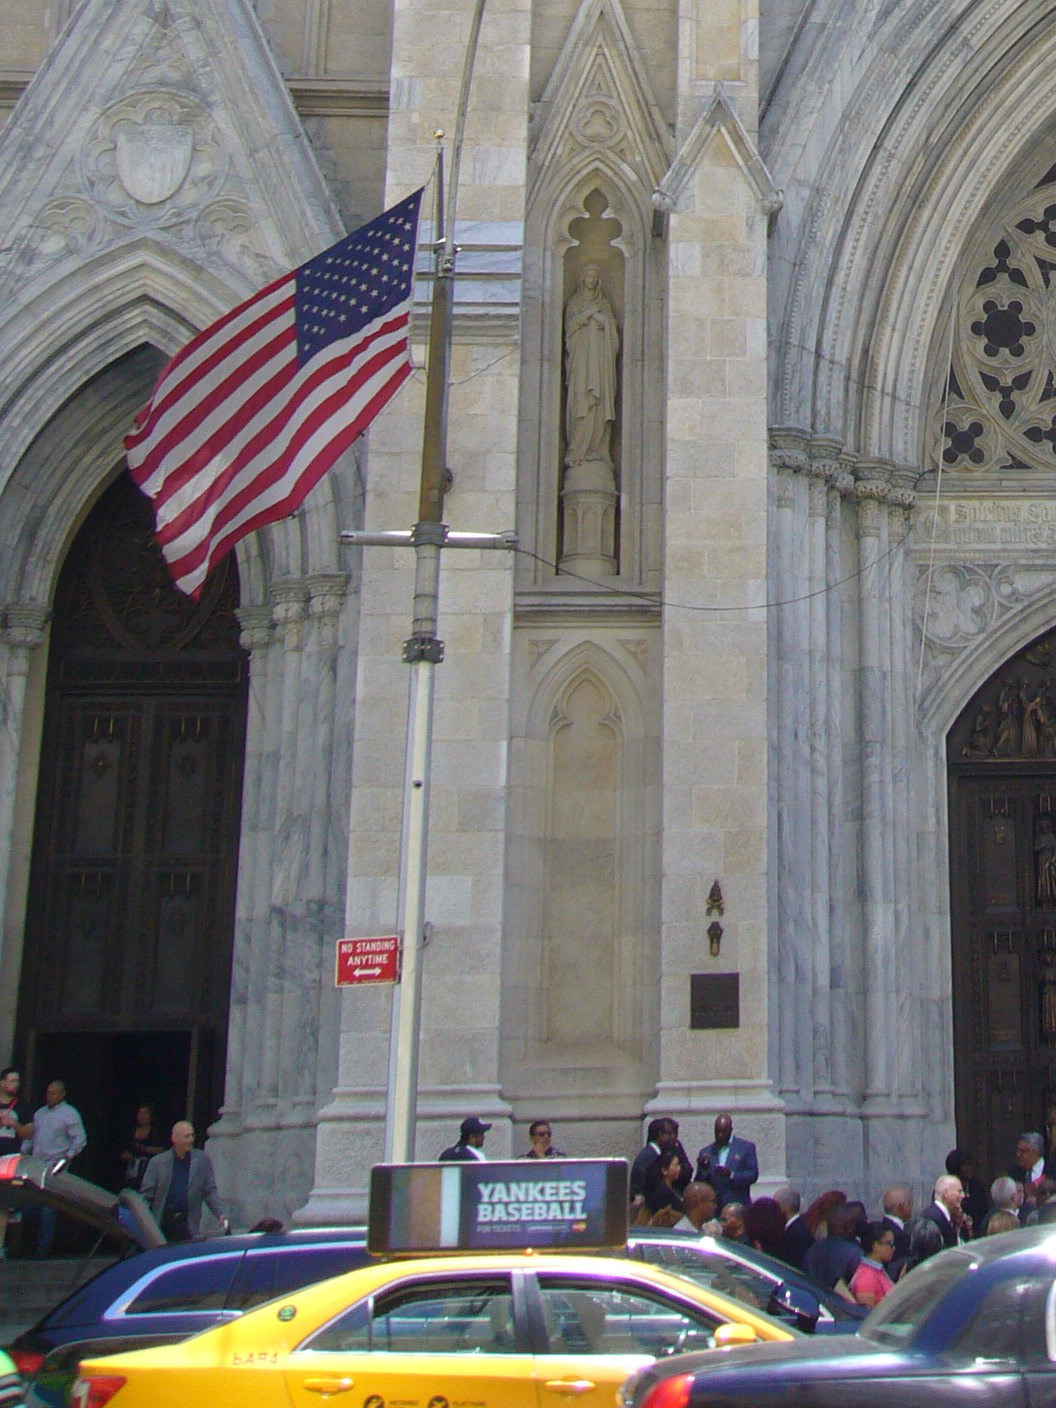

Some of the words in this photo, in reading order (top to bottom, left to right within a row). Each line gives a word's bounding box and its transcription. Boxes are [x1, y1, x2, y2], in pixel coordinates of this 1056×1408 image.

[341, 943, 353, 953] NO
[356, 940, 395, 952] STANDING
[346, 953, 388, 966] ANYTIME
[477, 1180, 587, 1203] YANKEES
[477, 1201, 588, 1222] BASEBALL
